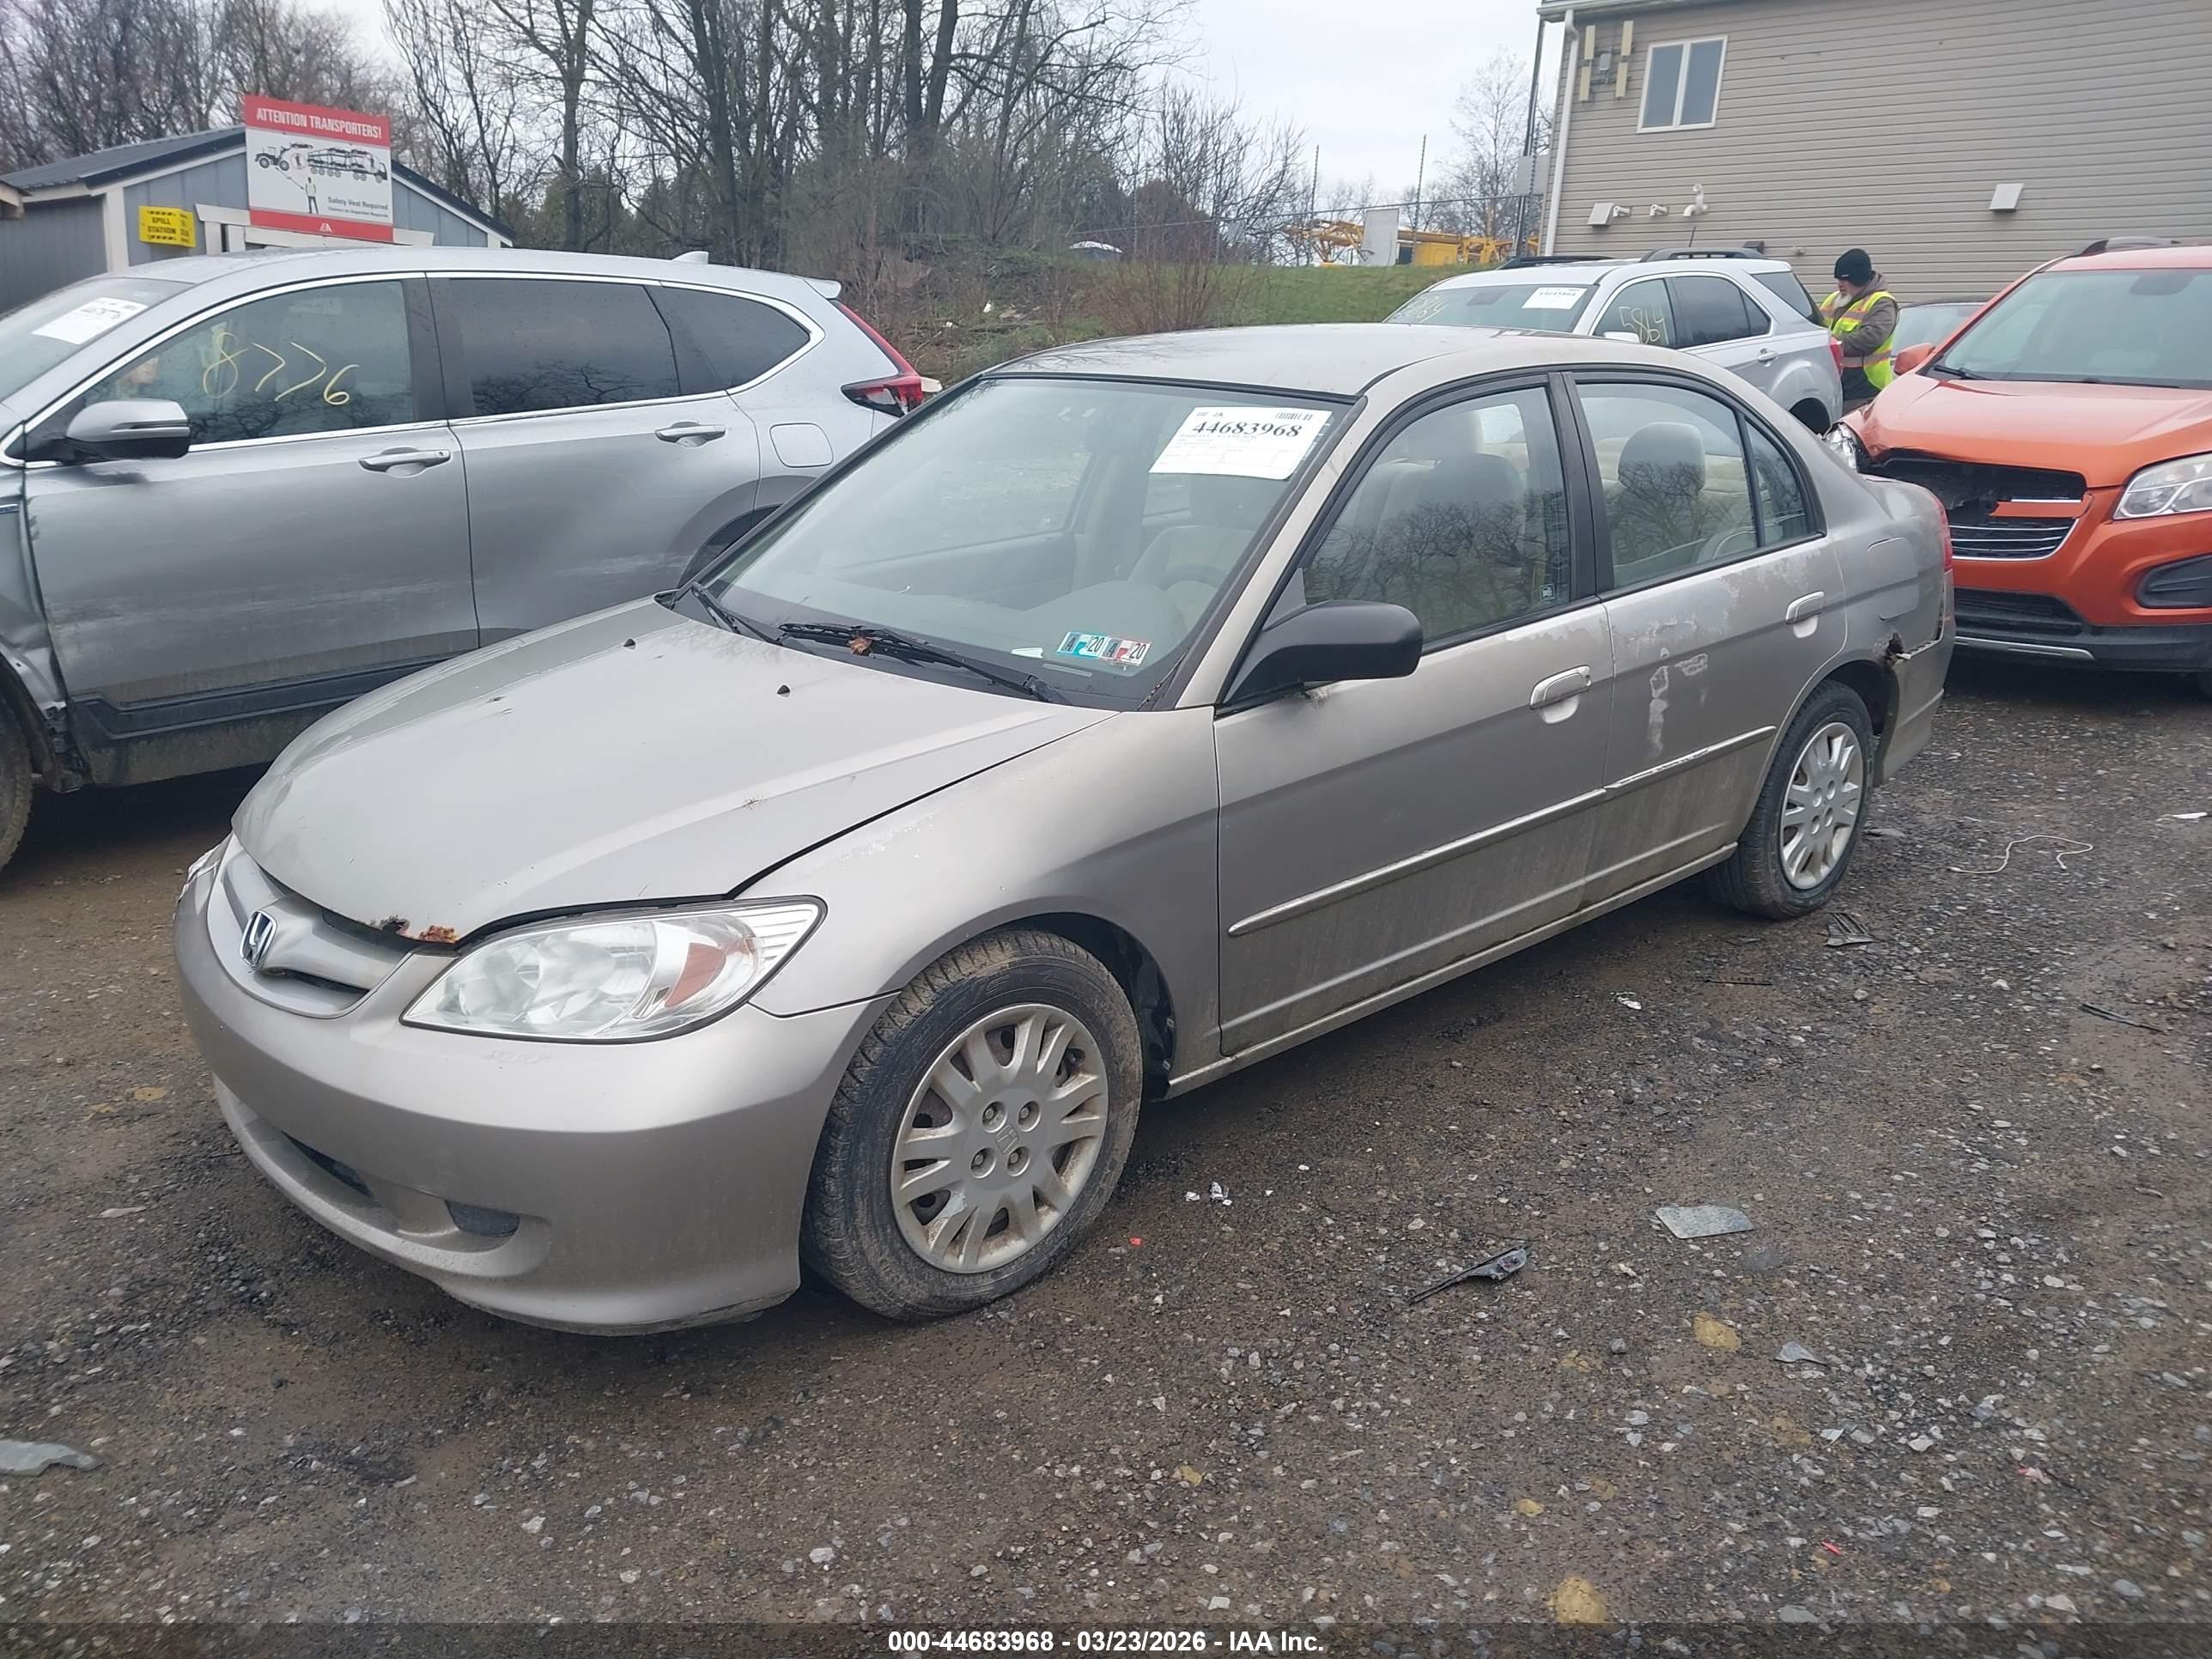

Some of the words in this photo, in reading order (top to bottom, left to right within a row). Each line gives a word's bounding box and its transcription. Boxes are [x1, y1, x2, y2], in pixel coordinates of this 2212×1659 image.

[257, 108, 307, 127] ATTENTION
[308, 115, 382, 138] TRANSPORTERS!
[1192, 421, 1303, 437] 44683968
